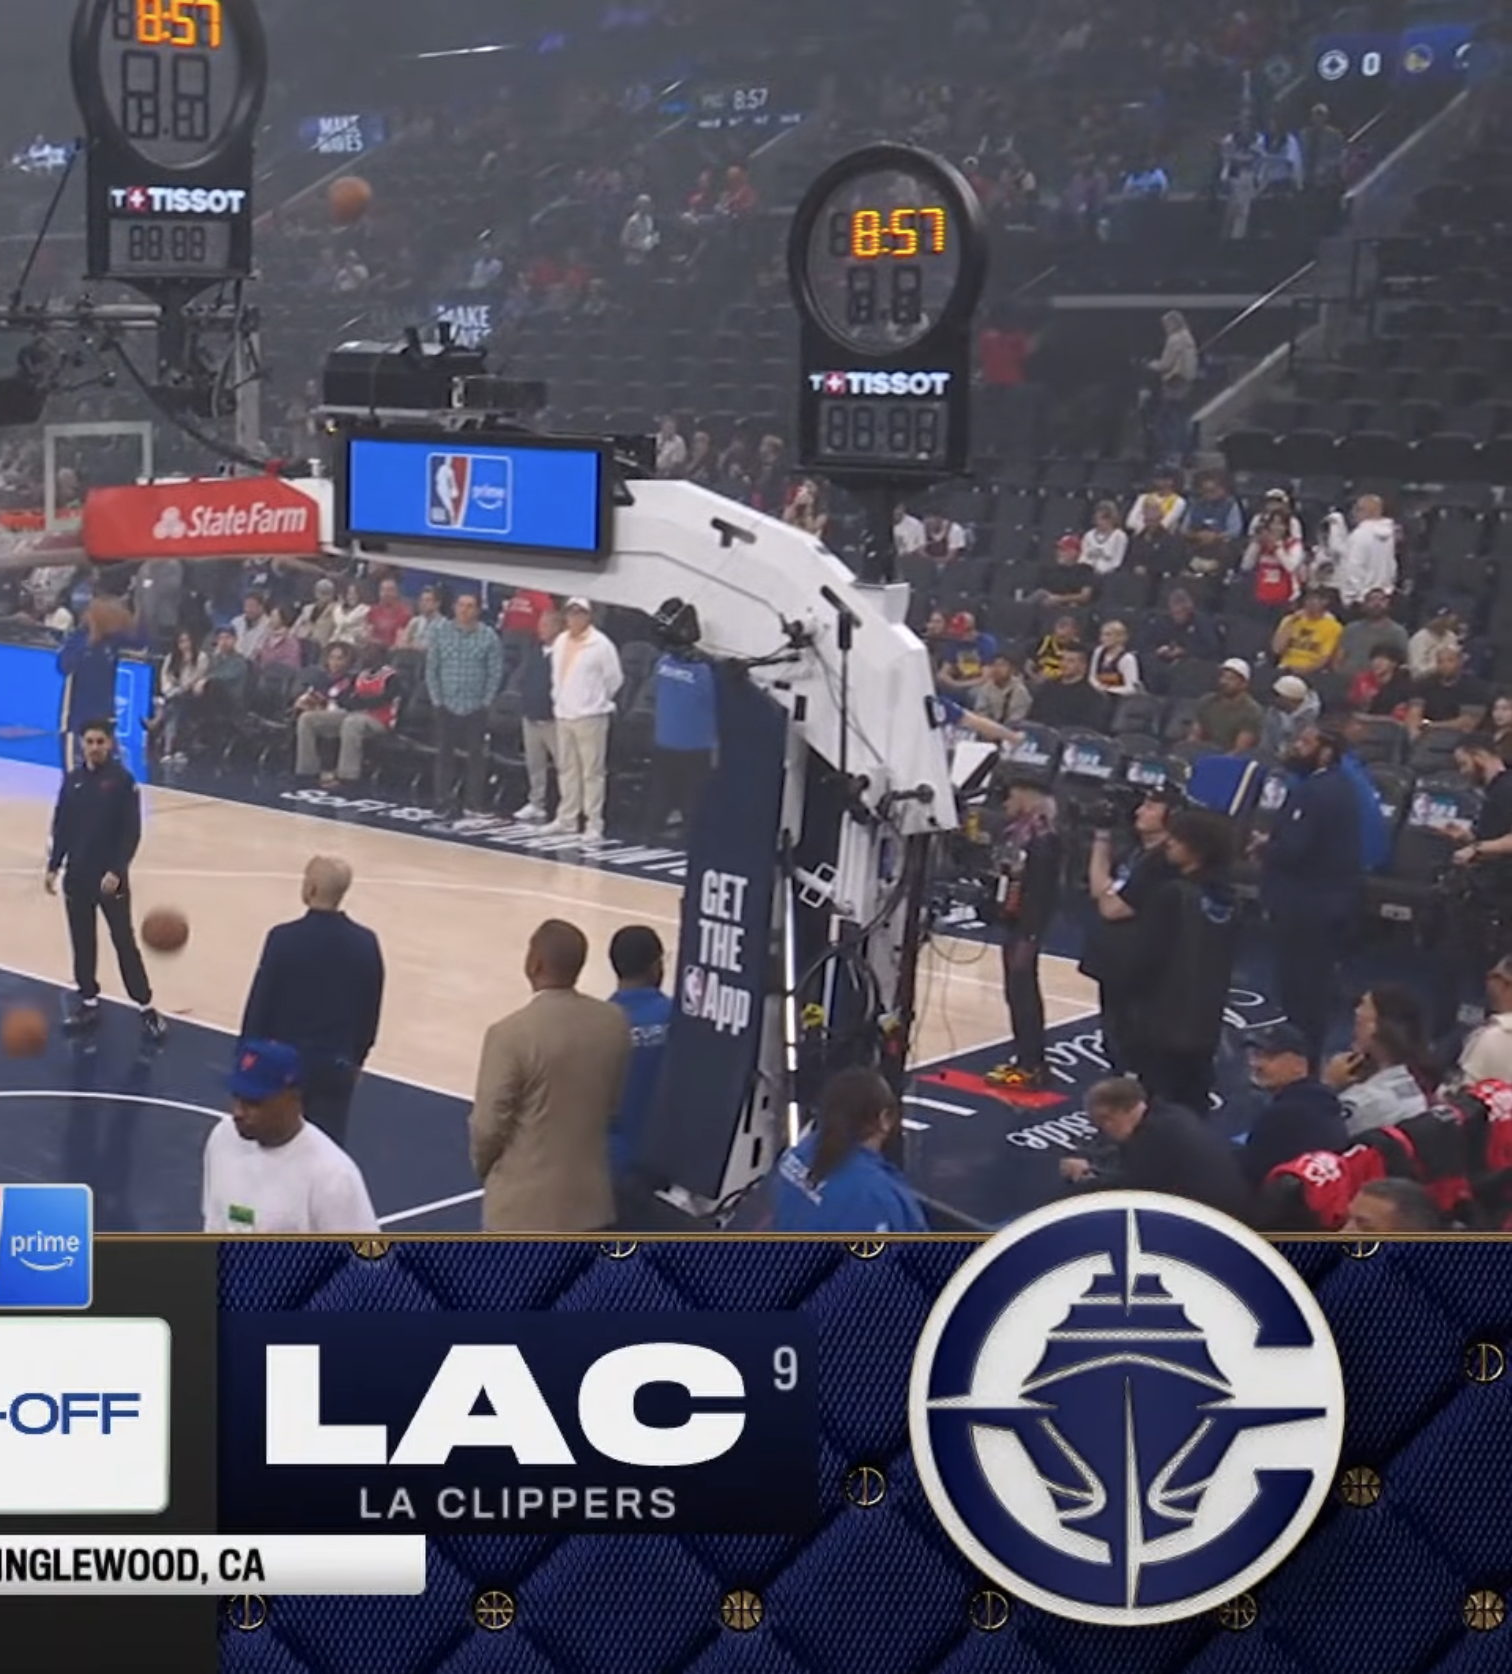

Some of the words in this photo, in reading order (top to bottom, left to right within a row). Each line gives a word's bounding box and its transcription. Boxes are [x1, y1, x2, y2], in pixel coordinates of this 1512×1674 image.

[136, 0, 221, 48] 8:57
[1362, 52, 1381, 76] 0
[147, 186, 246, 214] TISSOT
[852, 207, 946, 260] 8:57
[846, 371, 951, 396] TISSOT
[699, 868, 749, 922] GET
[697, 917, 745, 972] THE
[700, 970, 752, 1037] App
